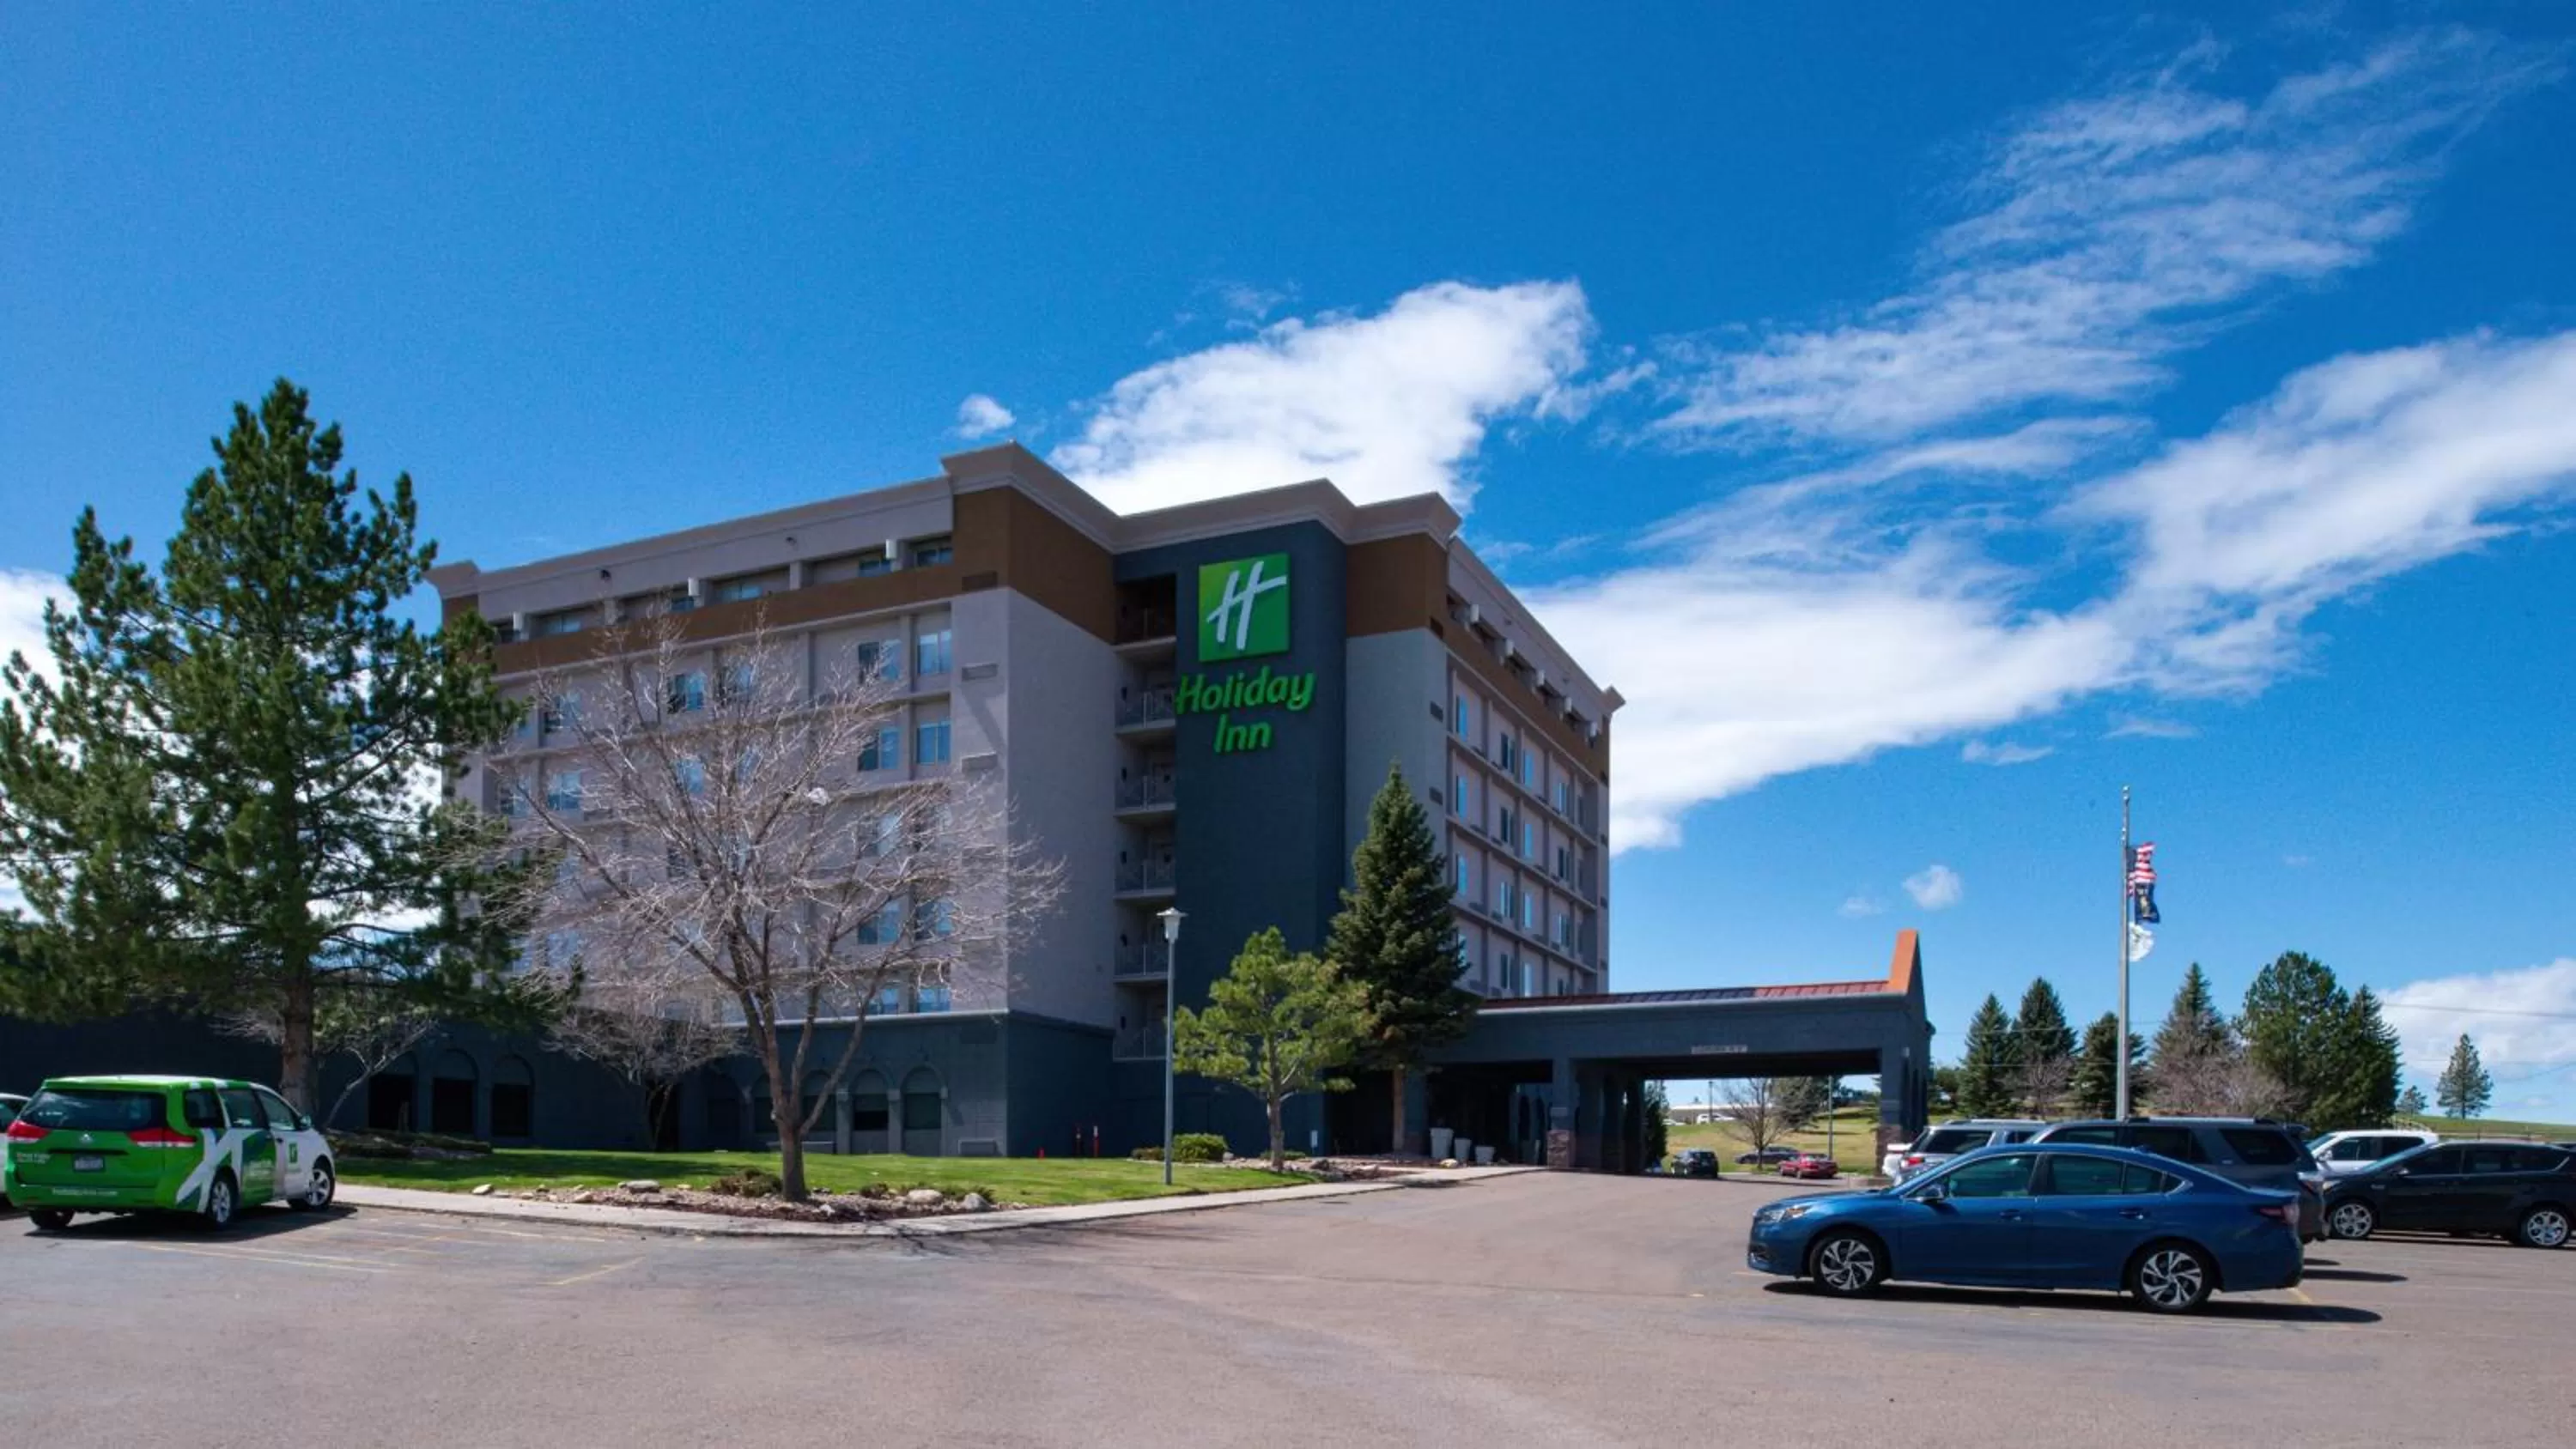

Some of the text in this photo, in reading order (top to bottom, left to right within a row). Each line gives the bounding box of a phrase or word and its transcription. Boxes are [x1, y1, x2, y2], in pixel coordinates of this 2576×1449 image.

[1206, 561, 1286, 650] H
[1176, 666, 1315, 714] Holiday
[1213, 713, 1272, 752] Inn
